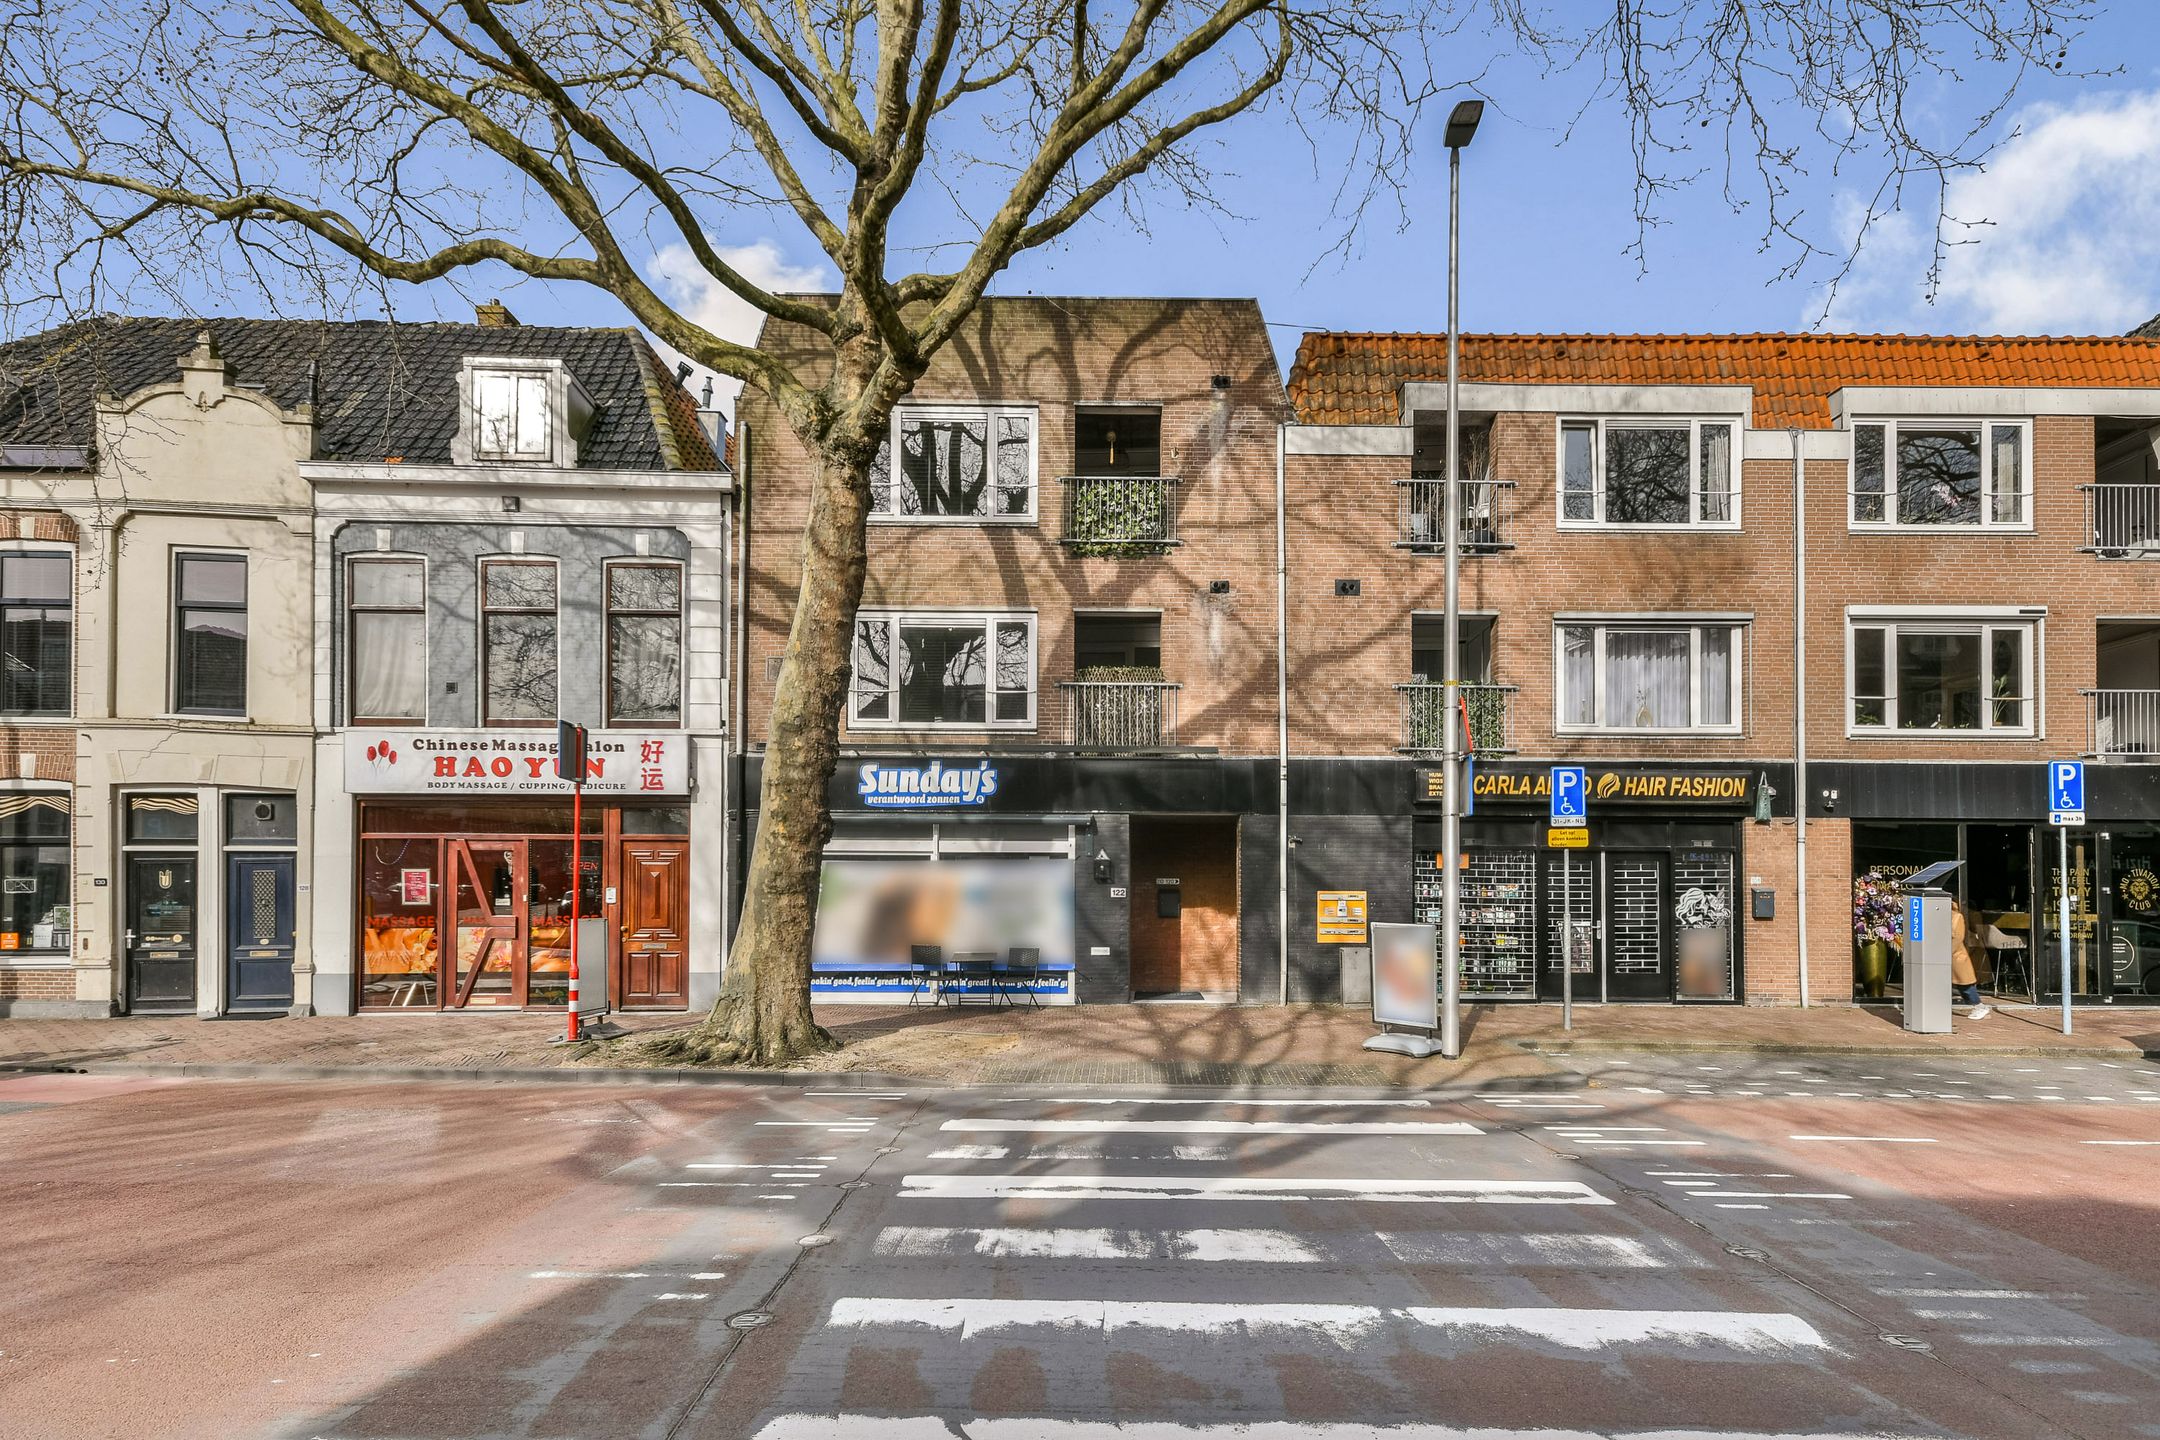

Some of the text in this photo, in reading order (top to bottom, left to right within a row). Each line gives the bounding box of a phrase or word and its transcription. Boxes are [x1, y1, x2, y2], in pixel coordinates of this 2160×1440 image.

[413, 738, 625, 754] Chinese Massag alon
[433, 756, 606, 779] HAO YN
[640, 740, 665, 791] 好运
[860, 760, 996, 802] Sunday's
[1559, 771, 1578, 797] P
[2058, 764, 2077, 790] P
[457, 782, 508, 790] MASSAGE
[1473, 775, 1531, 795] CARLA
[1623, 776, 1667, 796] HAIR
[1669, 777, 1746, 797] FASHION
[867, 794, 960, 804] verantwoord zonnen
[2052, 886, 2092, 897] TDAY
[2128, 899, 2152, 911] CLUB
[367, 915, 436, 927] MASSAGE
[811, 976, 833, 985] ookin'
